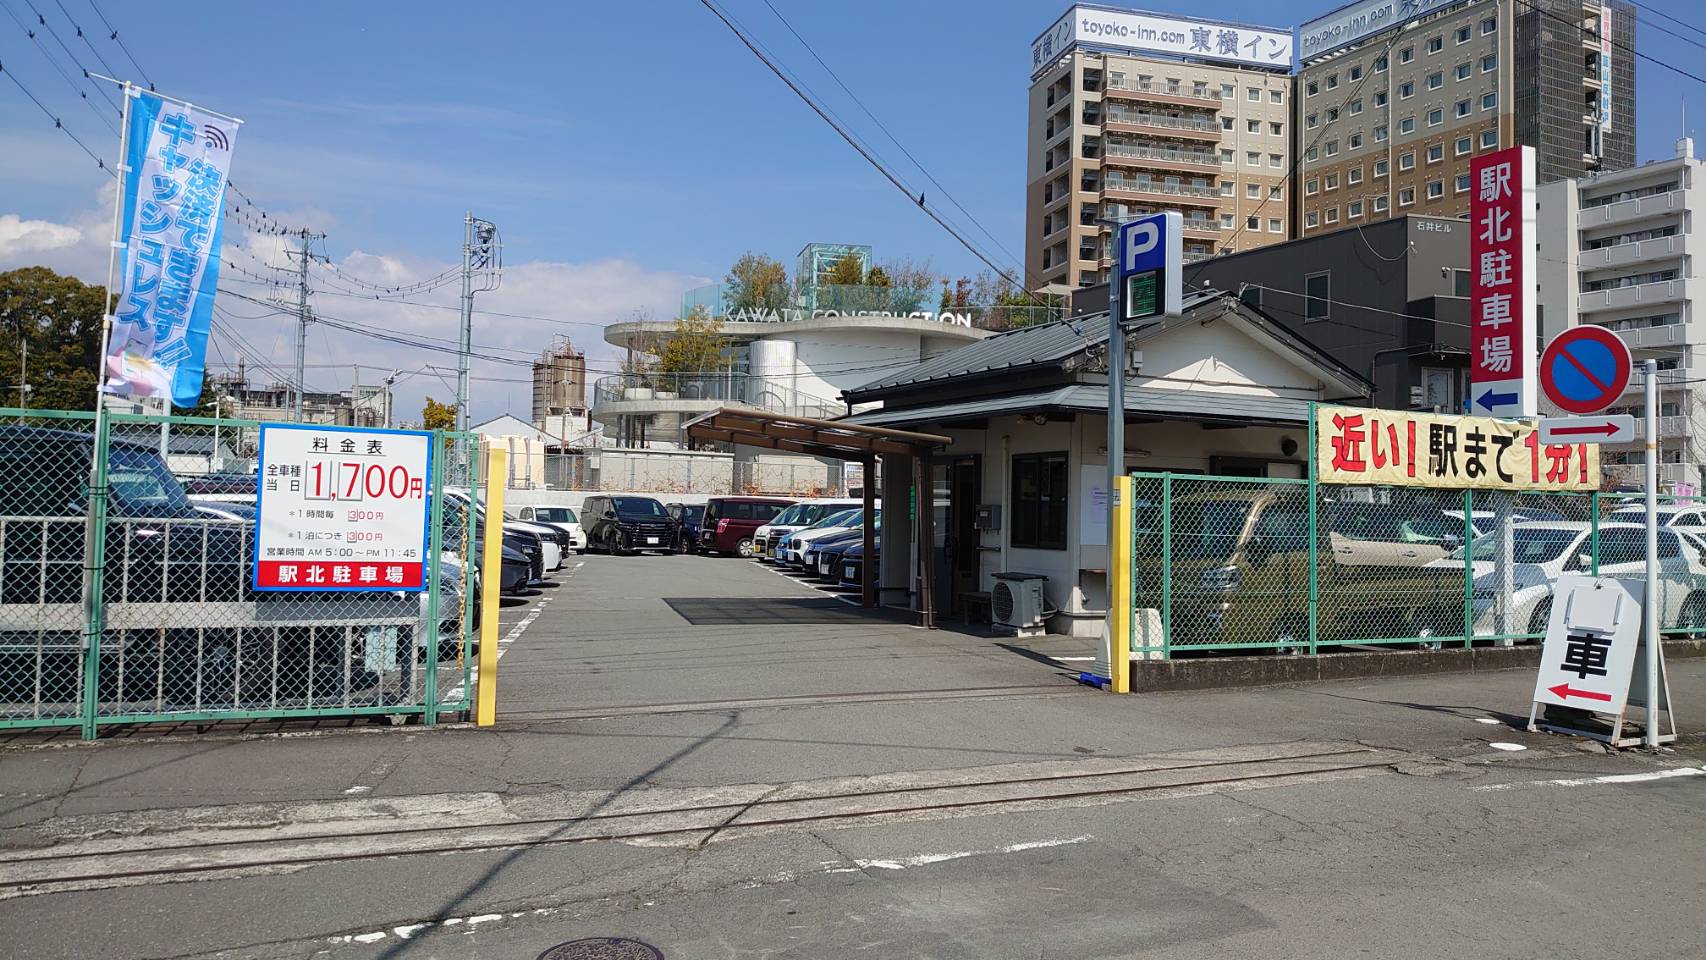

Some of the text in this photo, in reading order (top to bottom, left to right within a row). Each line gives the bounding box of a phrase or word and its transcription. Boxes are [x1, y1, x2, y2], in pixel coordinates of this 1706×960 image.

[1303, 4, 1394, 47] toyoko-inn.com
[1082, 18, 1288, 60] toyoko-inn.com 東横イン
[118, 112, 197, 332] キャッシュレス
[1416, 220, 1452, 233] 石井ビル
[1125, 221, 1160, 270] P
[1479, 161, 1513, 374] 駅北駐車場
[724, 306, 803, 323] KAWATA
[313, 436, 383, 455] 料金表
[266, 463, 301, 477] 全車種
[311, 461, 423, 501] 1,700円
[348, 509, 384, 520] 300円
[347, 531, 384, 542] 300円
[266, 547, 305, 557] 営業時間
[308, 548, 323, 557] AM
[325, 548, 353, 557] 5:00
[366, 549, 380, 557] PM
[384, 548, 417, 558] 11:45
[278, 564, 404, 584] 駅北駐車場
[1559, 633, 1613, 680] 車
